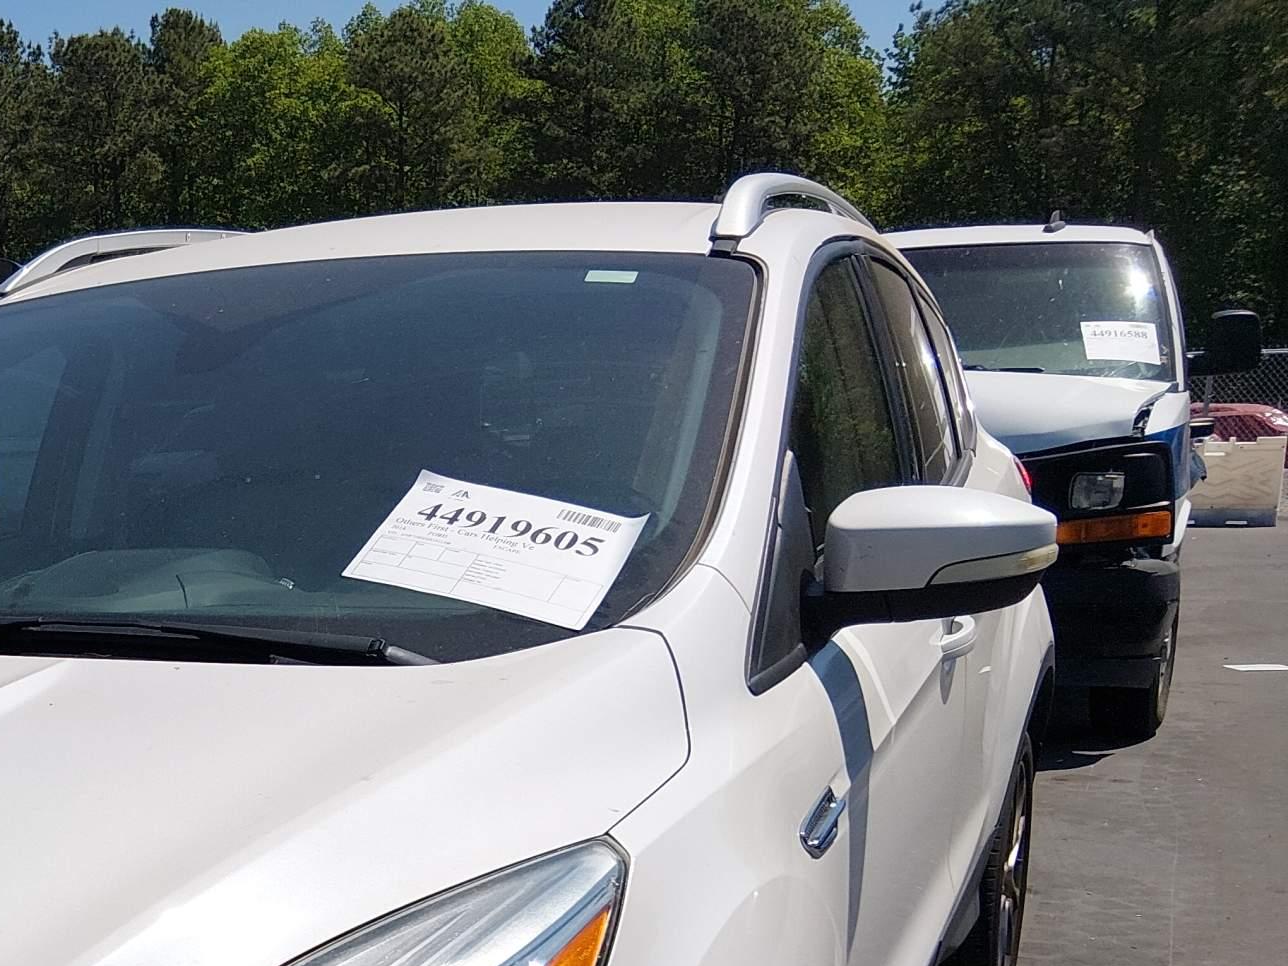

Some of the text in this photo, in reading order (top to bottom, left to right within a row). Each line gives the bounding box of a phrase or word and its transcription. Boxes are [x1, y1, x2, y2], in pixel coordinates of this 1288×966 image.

[395, 517, 425, 529] Others
[427, 523, 449, 533] First
[457, 528, 478, 537] Cars
[480, 533, 519, 548] Helping
[417, 503, 606, 557] 44919605
